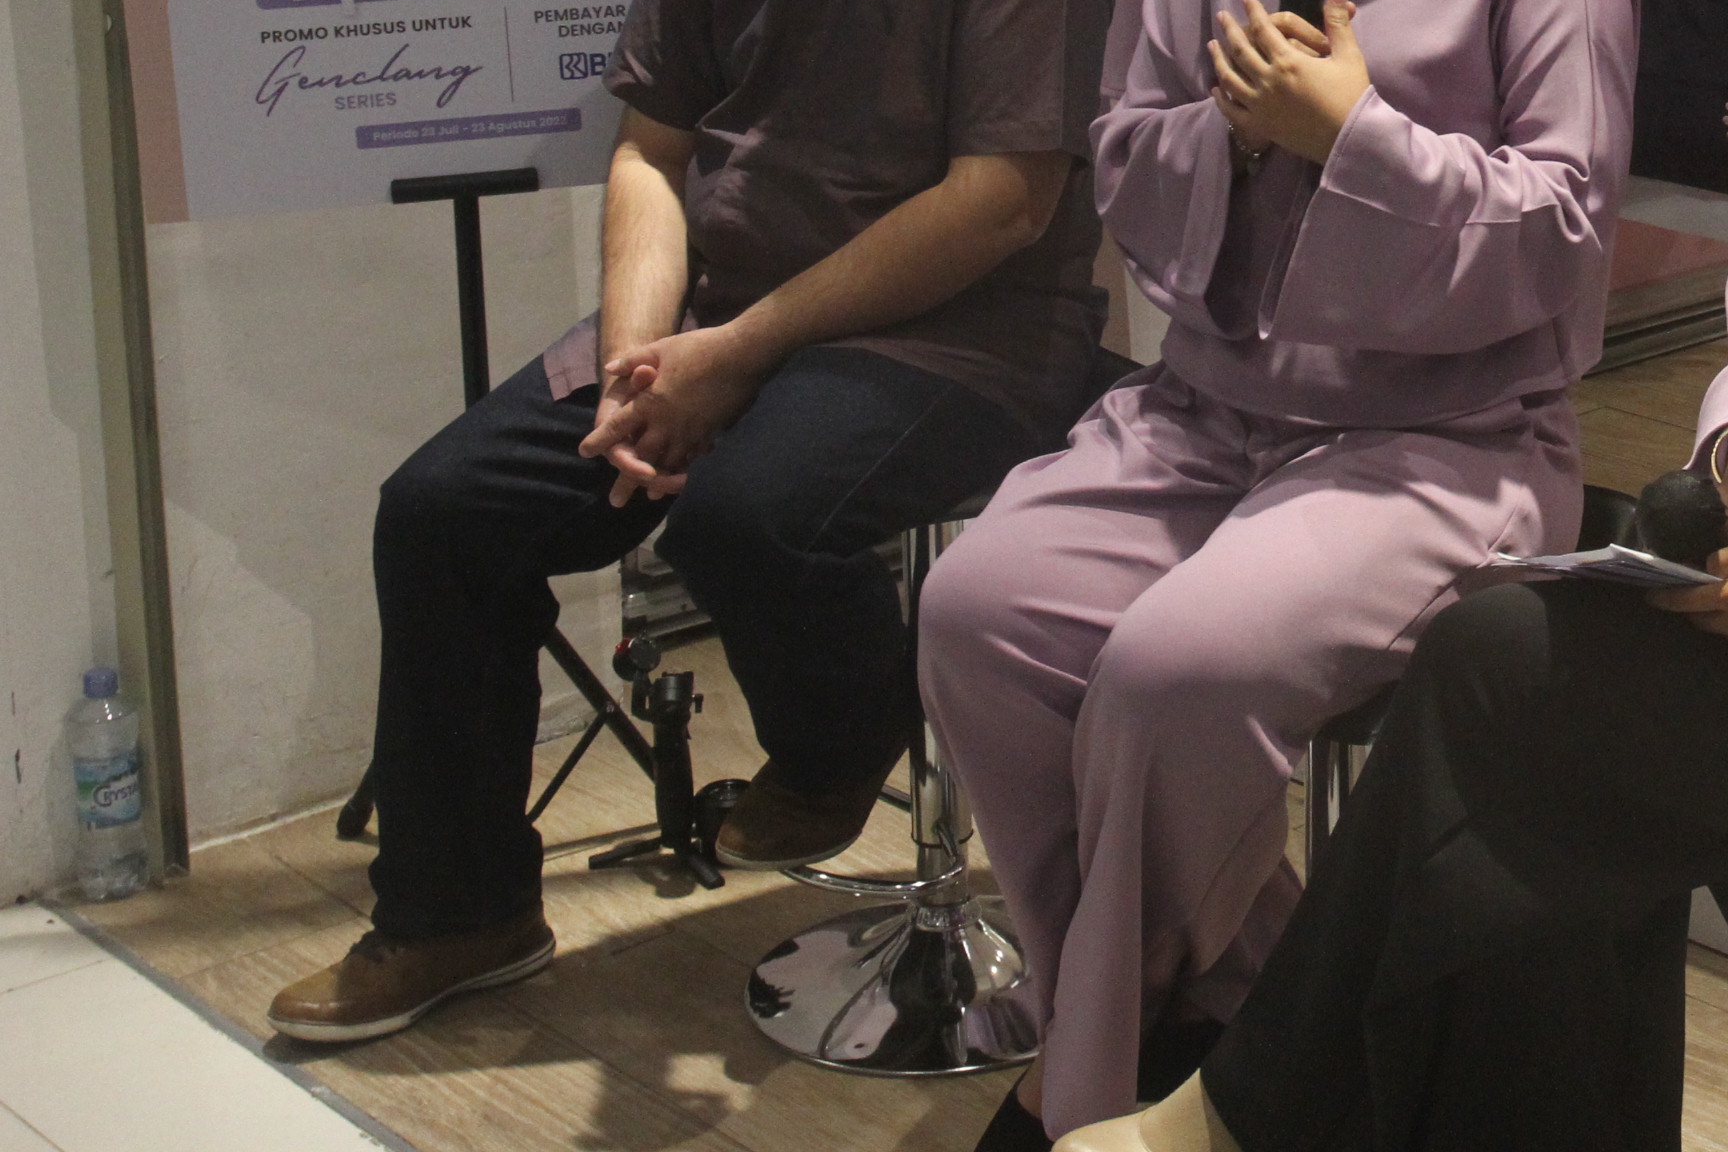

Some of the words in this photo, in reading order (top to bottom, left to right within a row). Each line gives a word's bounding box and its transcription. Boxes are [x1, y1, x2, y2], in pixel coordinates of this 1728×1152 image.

[534, 4, 626, 23] PEMBAYAR
[260, 26, 329, 44] PROMO
[334, 20, 407, 39] KHUSUS
[412, 15, 473, 32] UNTUK
[334, 92, 398, 111] SERIES
[373, 128, 419, 142] Periode
[438, 124, 460, 136] Juli
[471, 122, 486, 133] 23
[488, 119, 537, 133] Agustus
